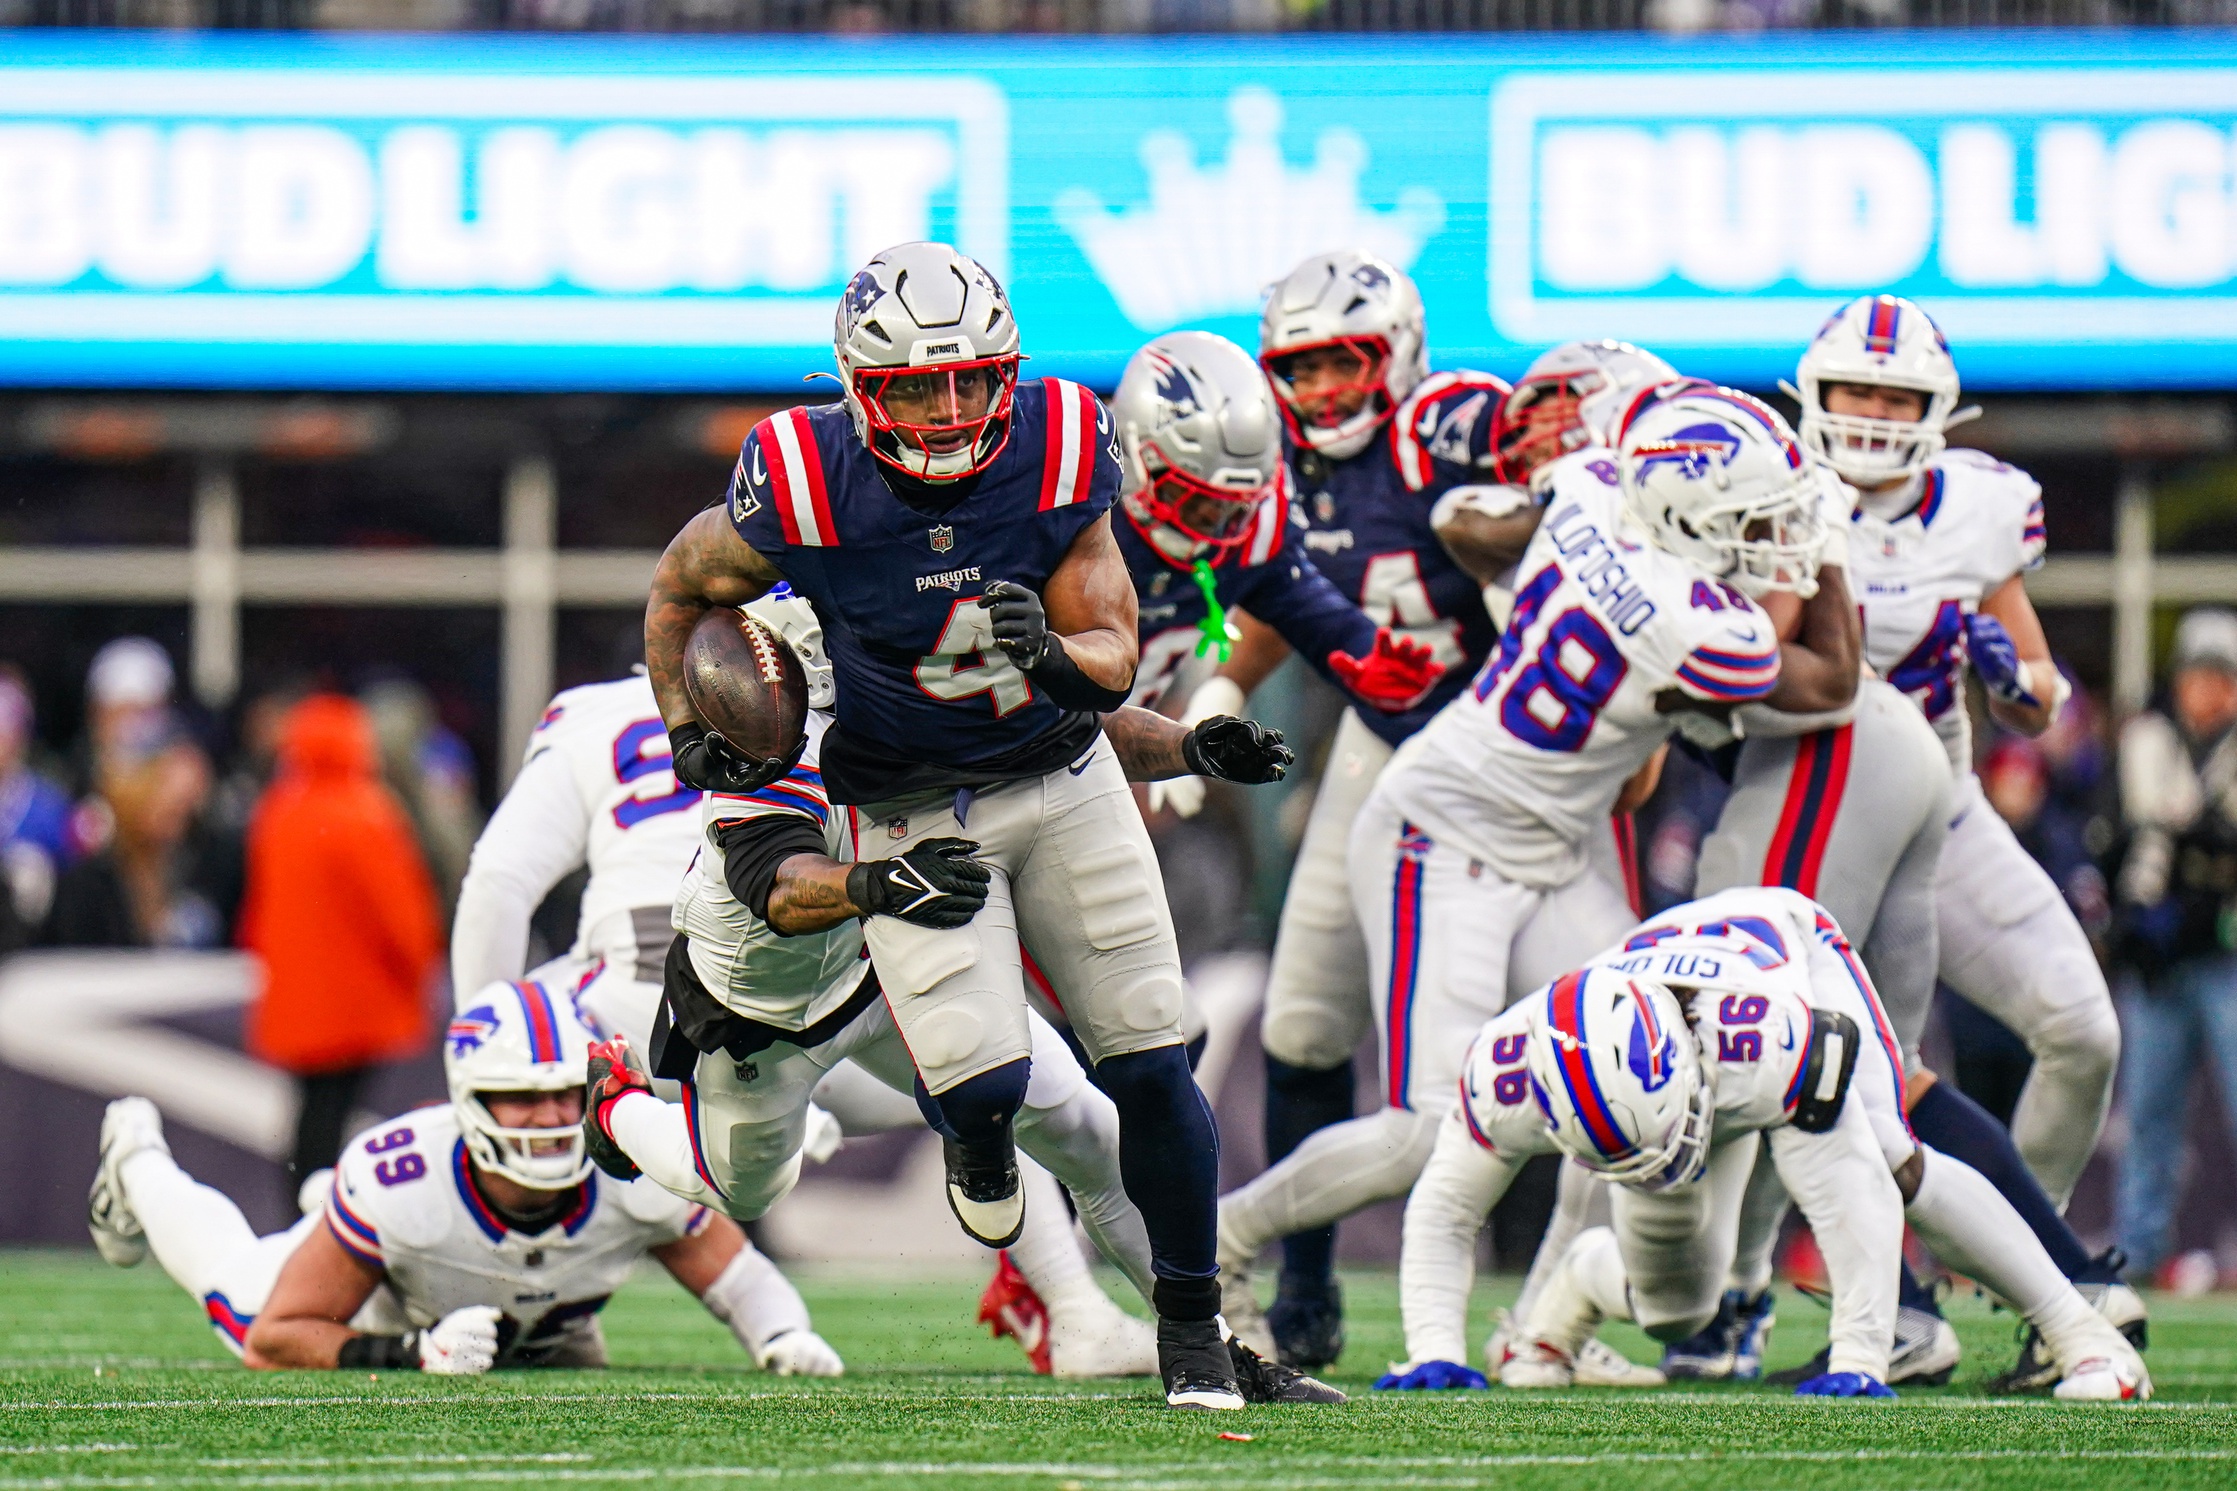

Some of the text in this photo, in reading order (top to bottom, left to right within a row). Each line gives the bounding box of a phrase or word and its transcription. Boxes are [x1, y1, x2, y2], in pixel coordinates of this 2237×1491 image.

[0, 120, 953, 292] BUD LIGHT
[1538, 118, 2237, 290] BUD LIG
[926, 343, 960, 358] PATRIOTS
[915, 566, 981, 593] PATRIOTS
[1360, 548, 1468, 675] 4
[911, 595, 1034, 720] 4
[611, 716, 705, 831] 9
[1492, 1032, 1529, 1106] 56
[1718, 994, 1770, 1063] 56
[364, 1127, 428, 1187] 99
